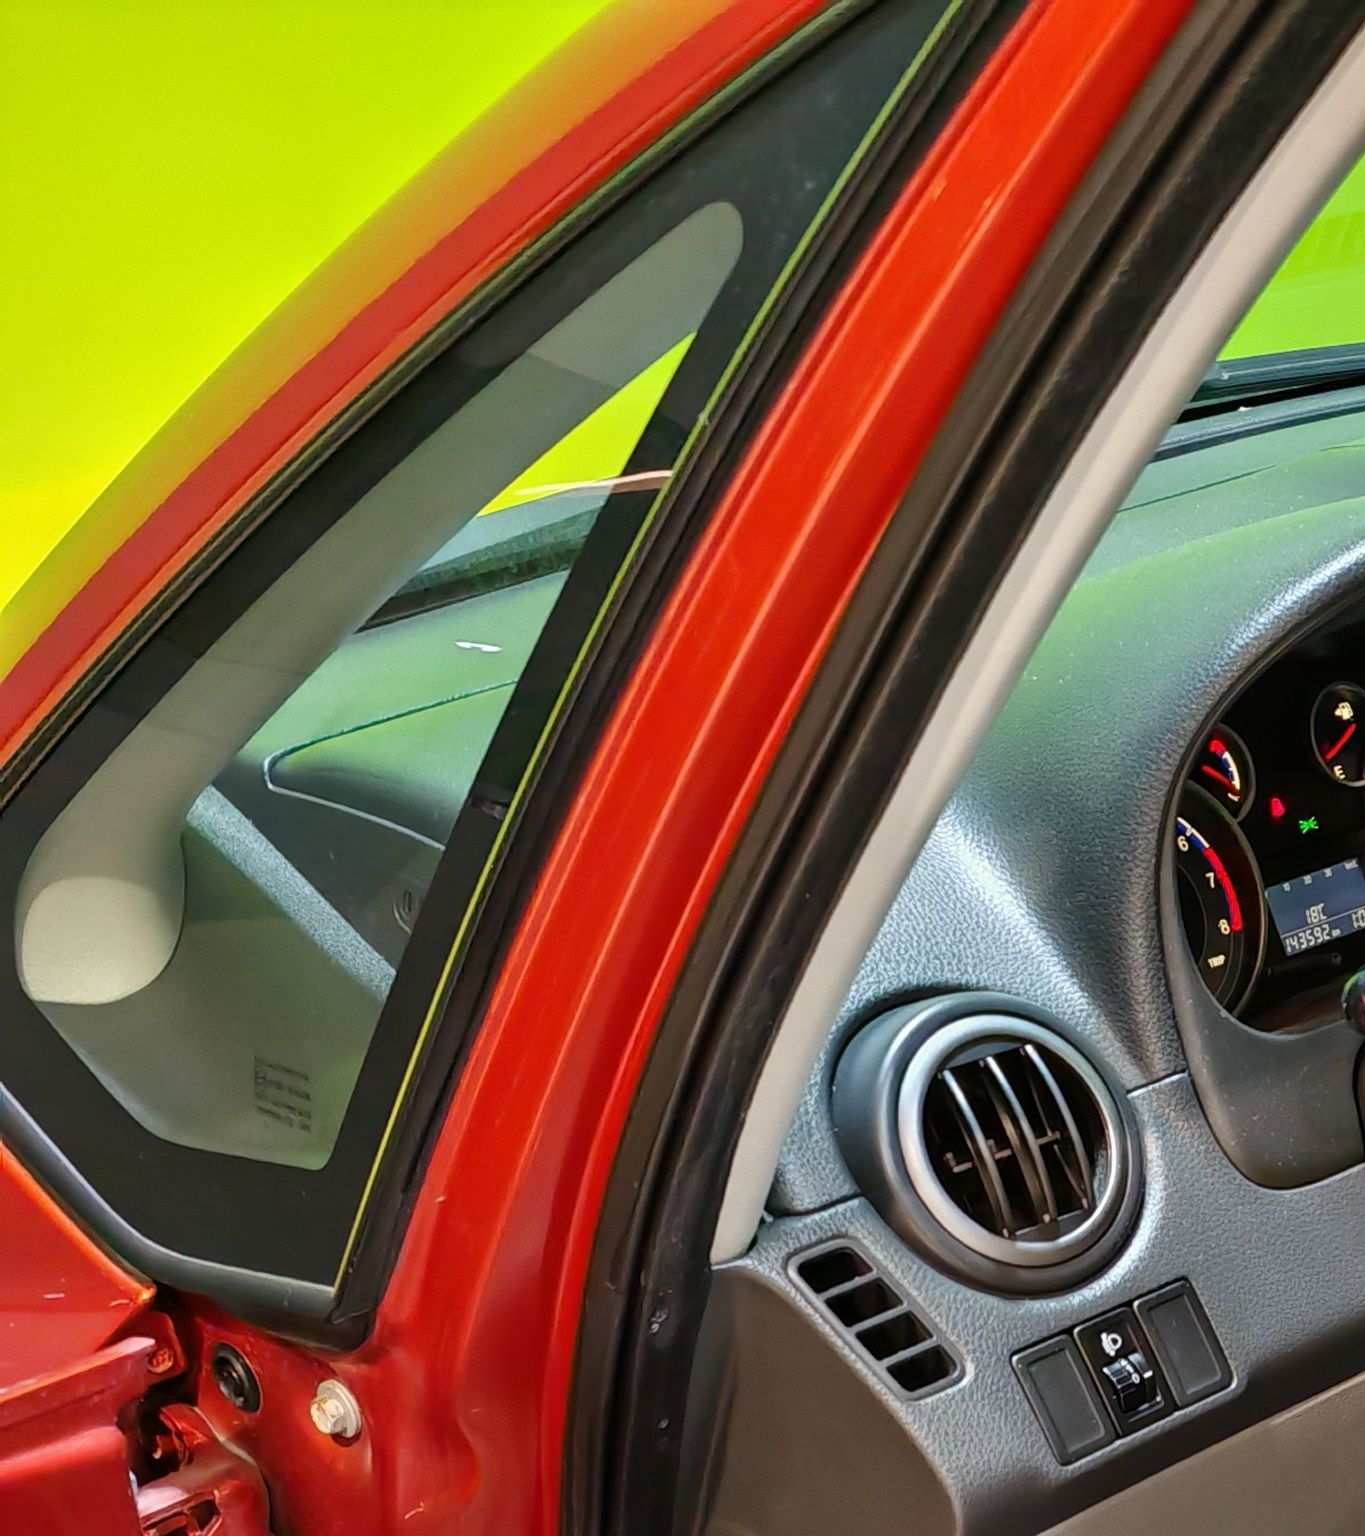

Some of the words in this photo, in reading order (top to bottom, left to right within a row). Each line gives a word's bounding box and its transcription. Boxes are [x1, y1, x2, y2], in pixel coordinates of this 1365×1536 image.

[1333, 765, 1346, 780] E
[1177, 835, 1189, 852] 6
[1205, 872, 1216, 889] 7
[1218, 918, 1231, 936] 8
[1285, 924, 1331, 953] 143592
